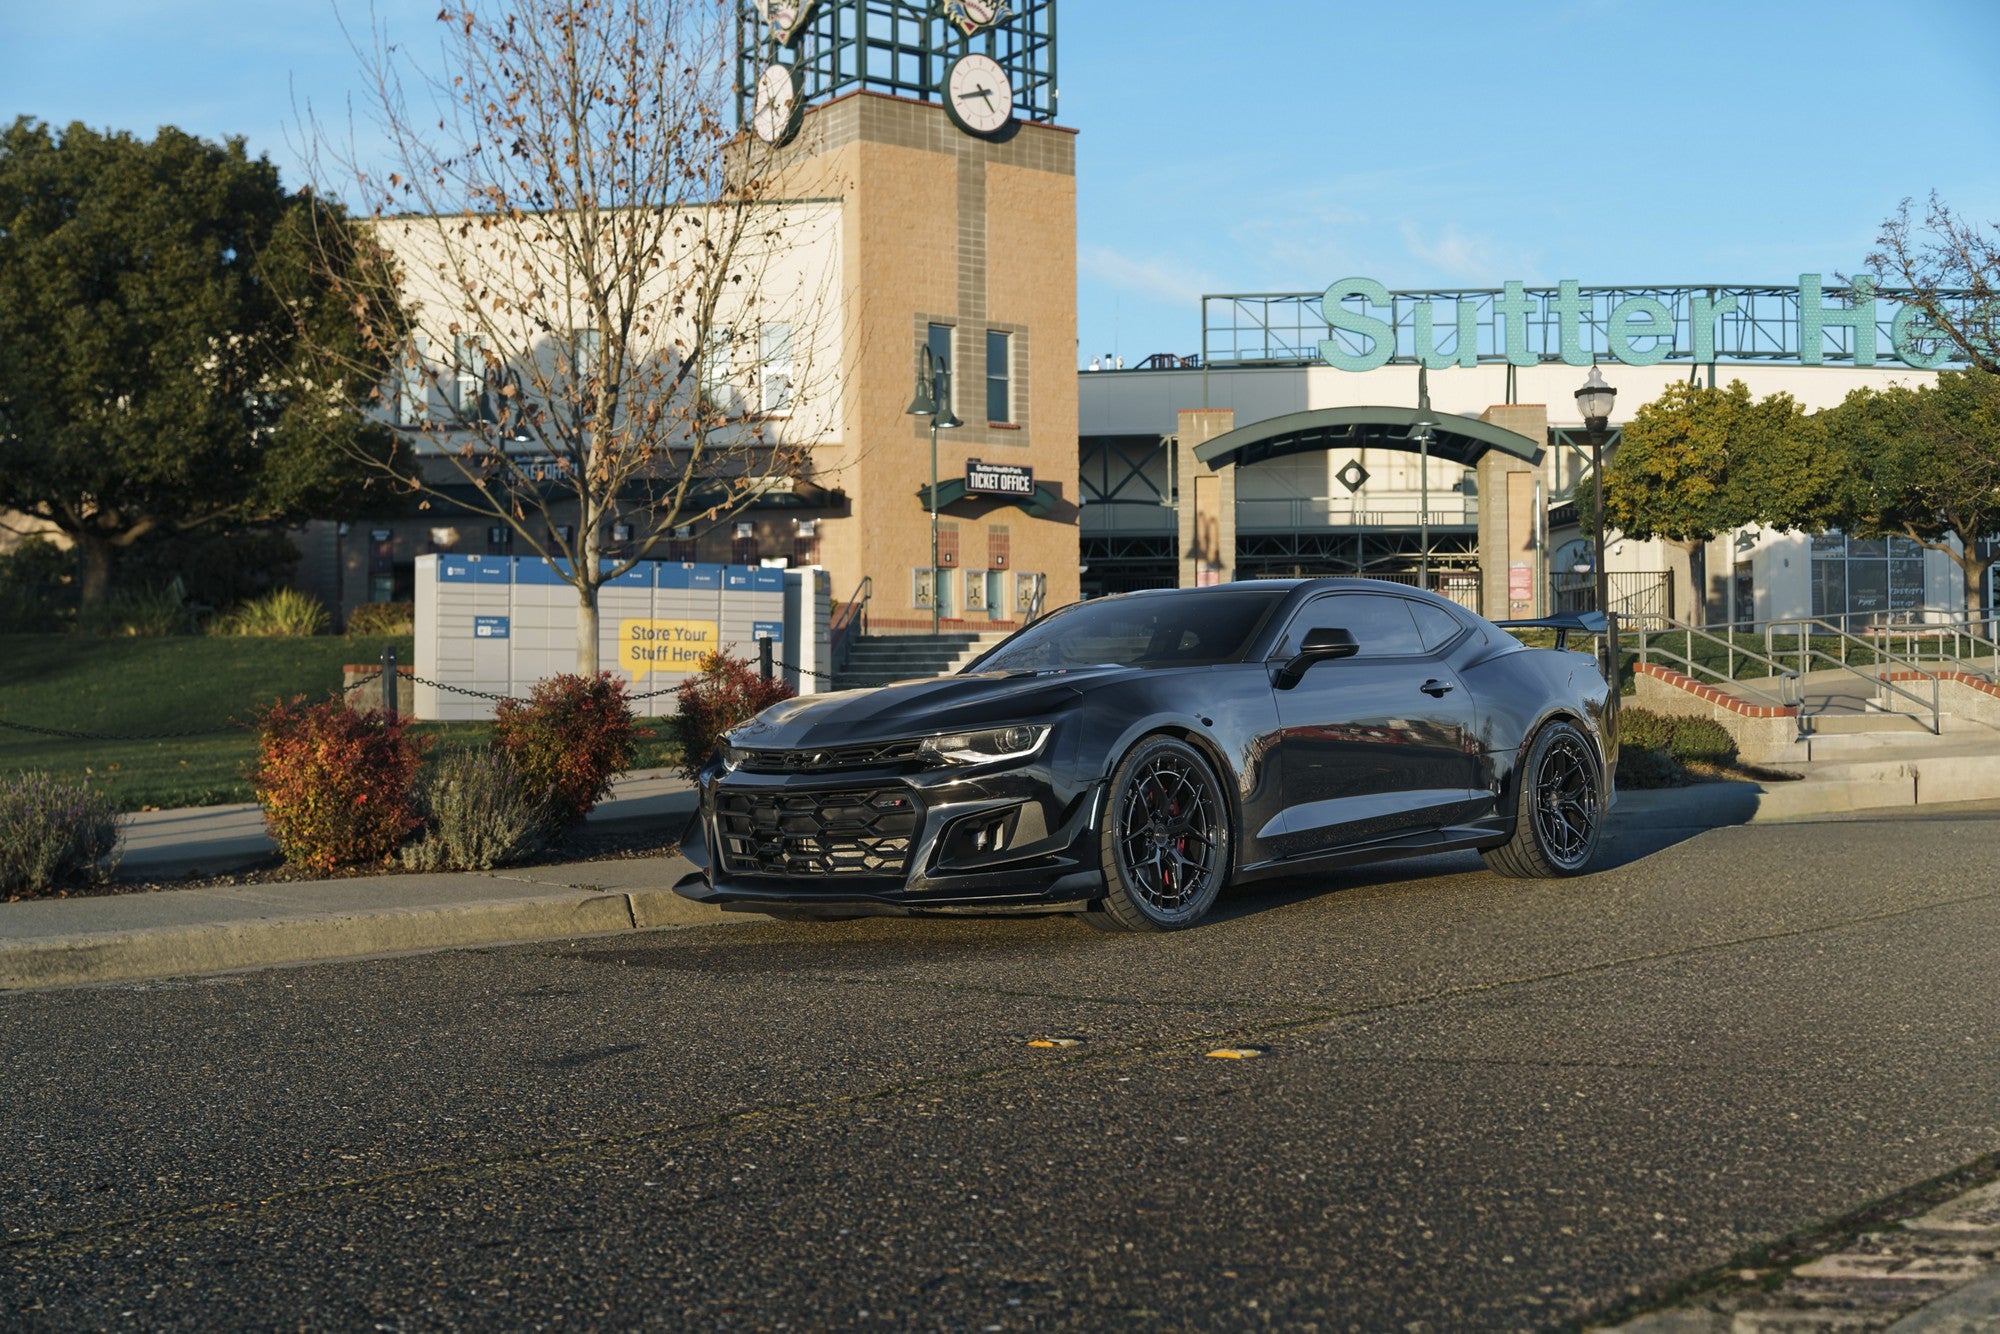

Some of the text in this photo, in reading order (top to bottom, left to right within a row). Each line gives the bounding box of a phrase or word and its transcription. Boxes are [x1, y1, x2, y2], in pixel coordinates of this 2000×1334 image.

[1317, 276, 1738, 373] Sutter
[970, 472, 1030, 492] TICKET OFFICE
[631, 625, 707, 641] Store Your
[631, 645, 707, 661] Stuff Here
